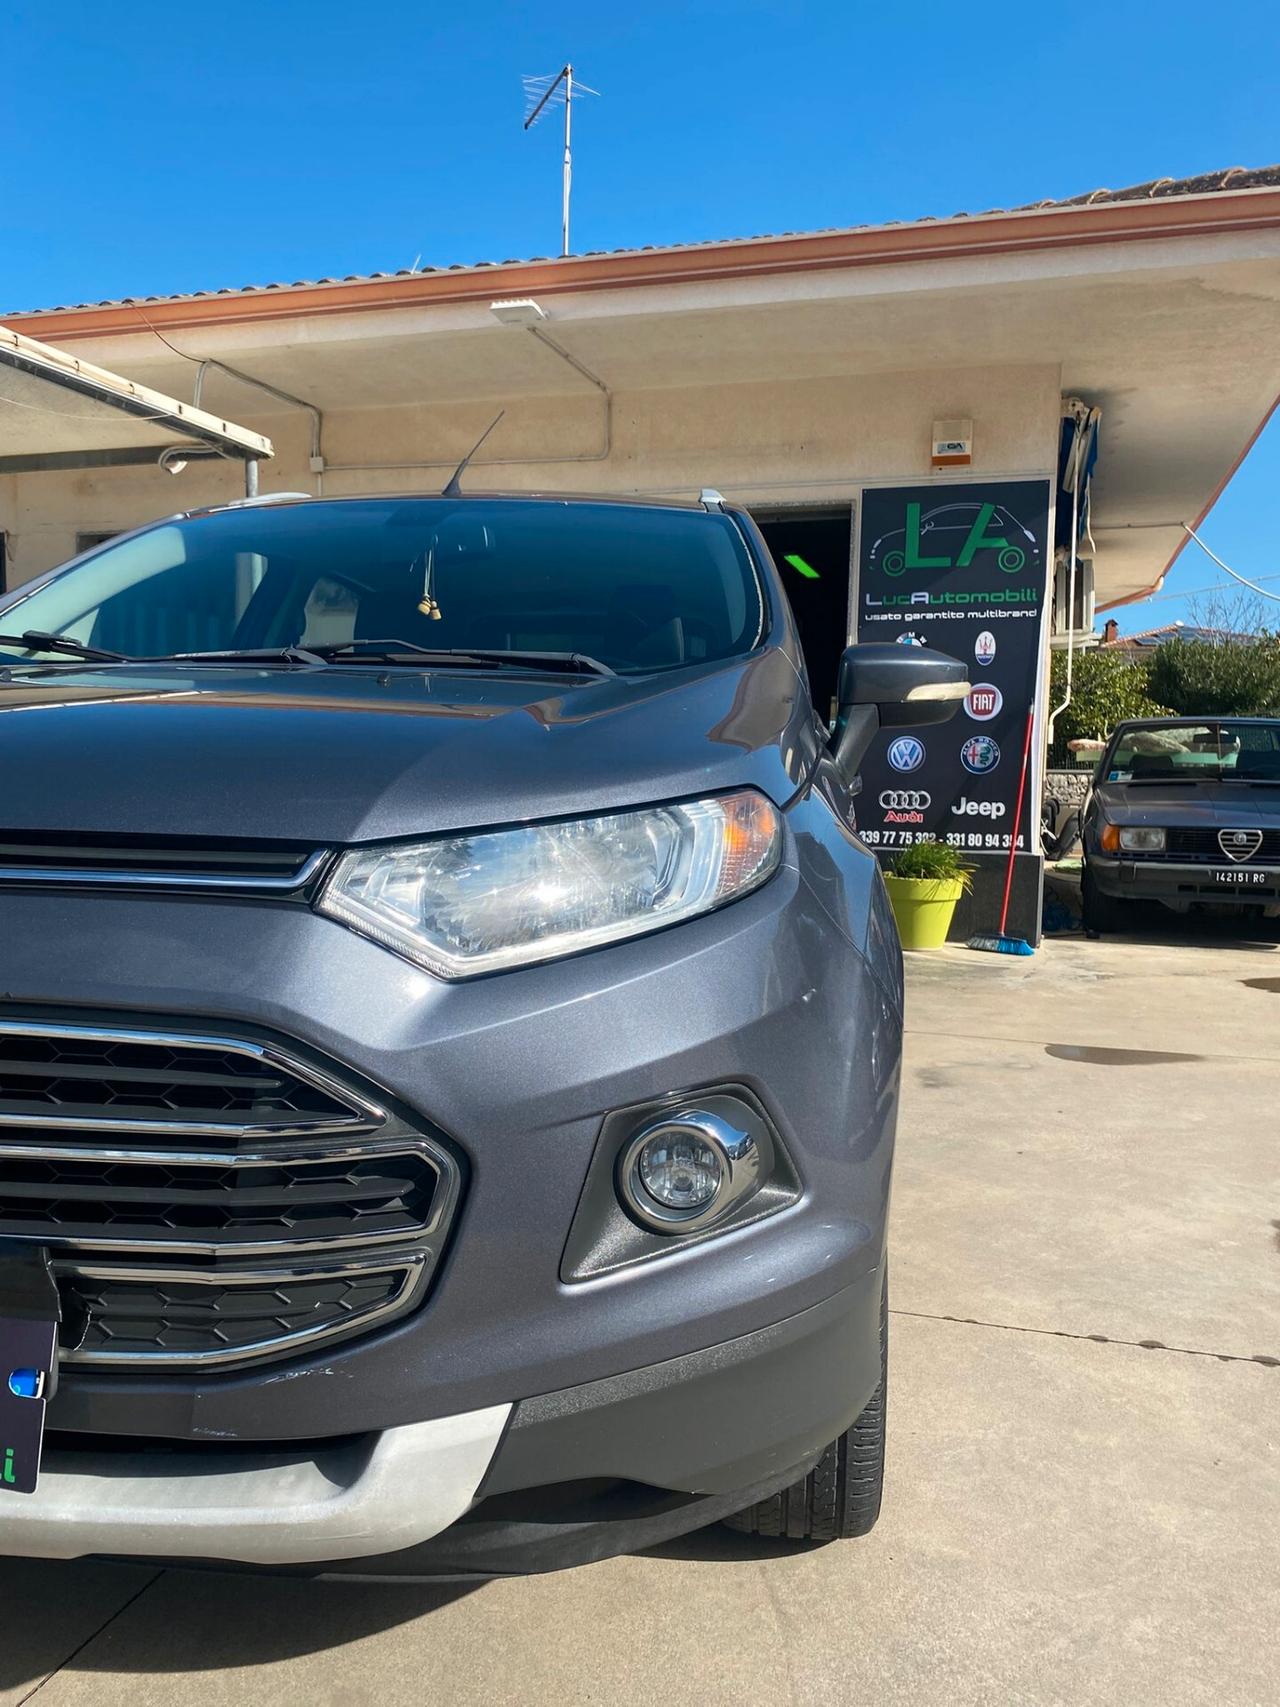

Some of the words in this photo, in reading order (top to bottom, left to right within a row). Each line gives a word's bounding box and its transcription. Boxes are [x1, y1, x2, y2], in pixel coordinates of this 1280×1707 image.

[865, 588, 1037, 606] LucAutomobili
[865, 612, 901, 621] usato
[904, 610, 965, 622] garantito
[967, 609, 1038, 619] multibrand
[972, 693, 995, 711] FIAT
[883, 810, 924, 824] Audi
[951, 796, 1006, 820] Jeep
[859, 830, 880, 844] 339
[882, 831, 897, 844] 77
[899, 831, 913, 845] 75
[946, 833, 965, 847] 331
[967, 833, 982, 847] 80
[985, 834, 1000, 848] 94
[1216, 872, 1249, 883] 142151
[1252, 873, 1265, 884] RG
